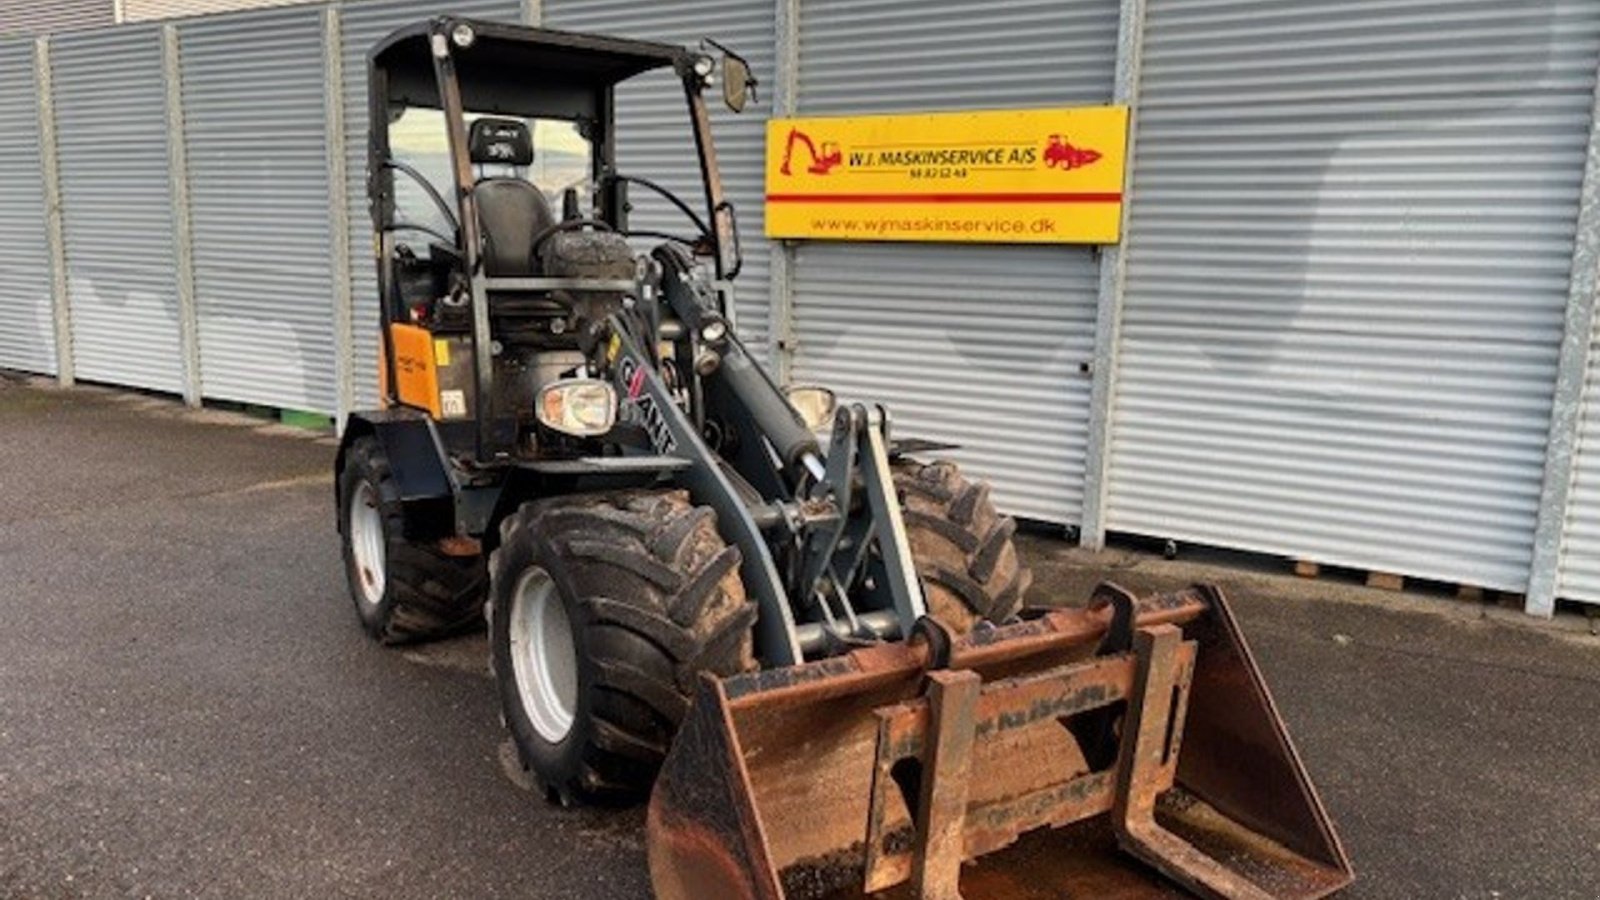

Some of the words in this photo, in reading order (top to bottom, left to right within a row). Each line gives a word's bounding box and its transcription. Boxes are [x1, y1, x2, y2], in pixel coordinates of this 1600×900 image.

[878, 149, 1003, 166] MASKINSERVICE
[1007, 147, 1037, 164] A/S
[812, 217, 1056, 234] www.wjmaskinservice.dk
